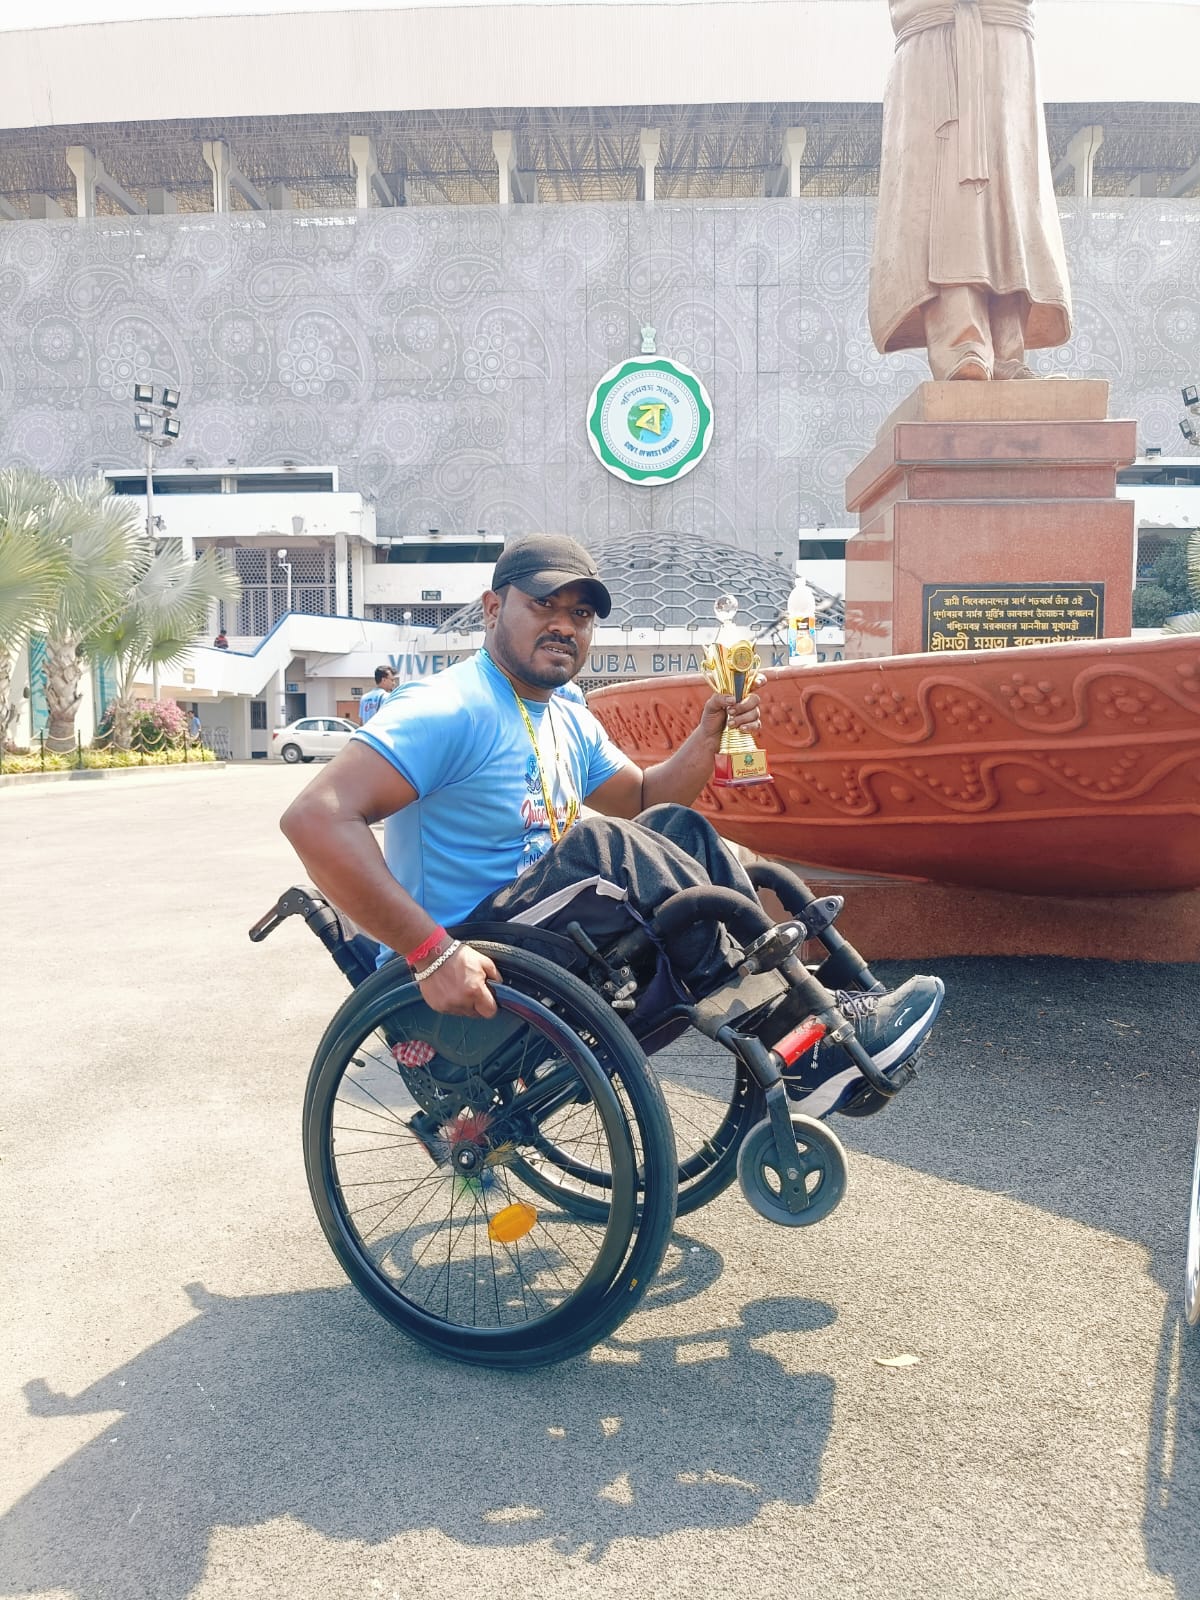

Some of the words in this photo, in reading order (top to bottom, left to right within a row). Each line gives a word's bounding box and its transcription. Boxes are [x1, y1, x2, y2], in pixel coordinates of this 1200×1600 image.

[388, 654, 460, 675] VIVEK
[591, 654, 637, 673] UBA
[652, 653, 699, 673] BHA
